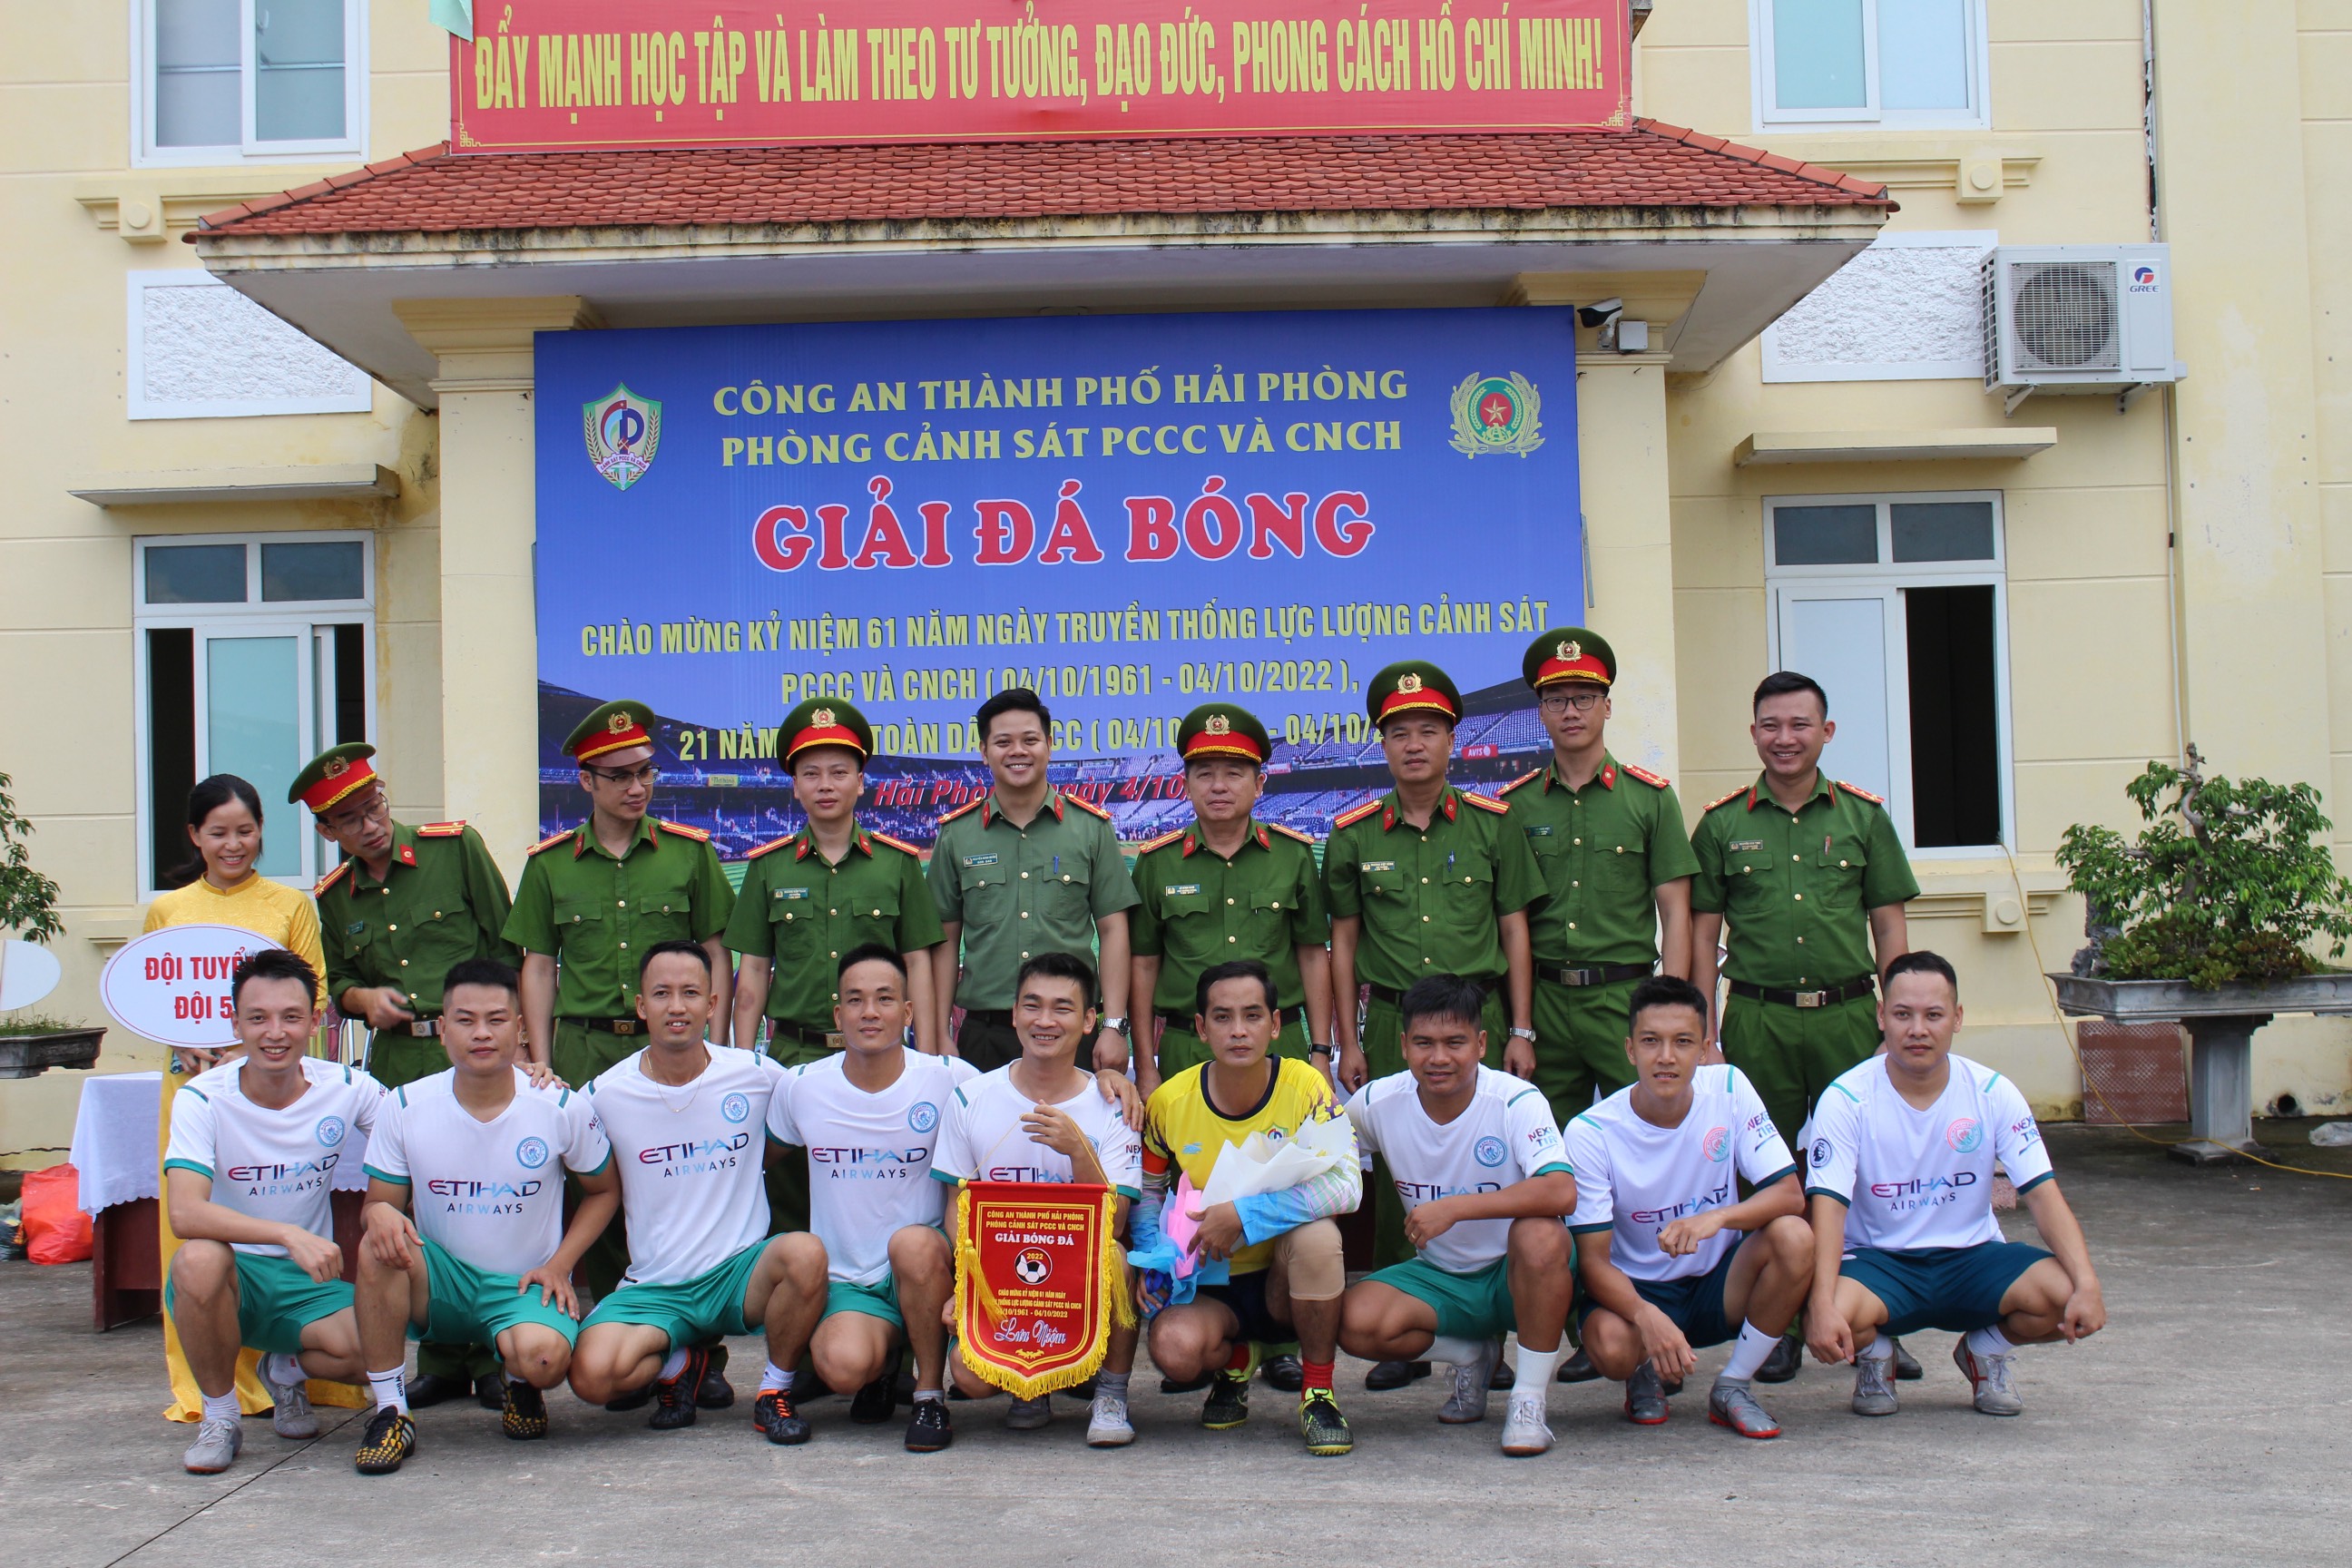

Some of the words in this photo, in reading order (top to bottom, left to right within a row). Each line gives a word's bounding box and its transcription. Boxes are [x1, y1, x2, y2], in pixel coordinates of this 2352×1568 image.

[475, 4, 529, 110] ĐẨY
[539, 33, 622, 124] MẠNH
[631, 31, 686, 122] HỌC
[693, 15, 747, 121] TẬP
[755, 14, 792, 103] VÀ
[799, 12, 859, 103] LÀM
[867, 26, 936, 101] THEO
[945, 18, 981, 100] TƯ
[986, 0, 1087, 105] TƯỞNG,
[1095, 23, 1152, 113] ĐẠO
[1160, 5, 1224, 103] ĐỨC,
[1233, 18, 1328, 94] PHONG
[1336, 3, 1411, 93] CÁCH
[1418, 0, 1456, 92] HỒ
[1465, 2, 1511, 91] CHÍ
[1519, 17, 1603, 90] MINH!
[2129, 285, 2160, 293] GREE
[713, 379, 836, 416] CÔNG
[847, 382, 906, 412] AN
[917, 373, 1063, 410] THÀNH
[1076, 366, 1161, 407] PHỐ
[1173, 364, 1245, 404] HẢI
[1258, 365, 1408, 401] PHÒNG
[721, 429, 872, 466] PHÒNG
[885, 422, 1001, 463] CẢNH
[1014, 423, 1089, 459] SÁT
[1102, 425, 1207, 456] PCCC
[1217, 417, 1276, 454] VÀ
[1285, 421, 1402, 452] CNCH
[752, 475, 952, 573] GIẢI
[973, 478, 1104, 567] ĐÁ
[1123, 475, 1376, 563] BÓNG
[582, 618, 653, 656] CHÀO
[661, 615, 740, 654] MỪNG
[749, 609, 783, 651] KỶ
[789, 612, 860, 656] NIỆM
[867, 617, 897, 649] 61
[906, 609, 969, 647] NĂM
[976, 608, 1049, 645] NGÀY
[1056, 600, 1160, 643] TRUYỀN
[1167, 597, 1258, 640] THỐNG
[1264, 603, 1315, 645] LỰC
[1322, 601, 1411, 644] LƯỢNG
[1417, 593, 1492, 635] CẢNH
[1499, 594, 1549, 632] SÁT
[781, 671, 855, 704] PCCC
[861, 664, 897, 702] VÀ
[903, 669, 976, 701] CNCH
[1002, 664, 1151, 697] 04/10/1961
[1179, 660, 1332, 693] 04/10/2022
[680, 730, 708, 760] 21
[720, 721, 778, 760] NĂM
[871, 718, 940, 755] TOÀN
[947, 715, 980, 754] DÂ
[1468, 747, 1483, 757] AVIS
[874, 778, 927, 806] Hải
[930, 778, 995, 805] Phò
[145, 952, 181, 985] ĐỘI
[190, 946, 253, 979] TUYỂ
[174, 991, 211, 1024] ĐỘI
[220, 996, 232, 1018] 5
[1747, 1110, 1770, 1131] NEXE
[1756, 1123, 1776, 1138] TIR
[1527, 1126, 1555, 1142] NEXE
[1535, 1137, 1557, 1148] TIR
[639, 1132, 749, 1164] ETIHAD
[812, 1147, 927, 1163] ETIHAD
[1125, 1144, 1142, 1154] NEX
[228, 1153, 339, 1181] ETIHAD
[663, 1157, 736, 1178] AIRWAYS
[831, 1169, 906, 1179] AIRWAYS
[989, 1167, 1073, 1183] ETIHA
[249, 1177, 322, 1196] AIRWAYS
[428, 1180, 542, 1198] ETIHAD
[1870, 1171, 1976, 1198] ETIHAD
[446, 1203, 523, 1214] AIRWAYS
[1890, 1192, 1956, 1211] AIRWAYS
[1067, 1223, 1084, 1231] CNCH
[995, 1230, 1020, 1242] GIẢI
[1023, 1232, 1054, 1245] BÓNG
[1057, 1234, 1074, 1245] ĐÁ
[1034, 1309, 1068, 1318] 04/10/2022
[994, 1317, 1030, 1342] Lưu
[1032, 1319, 1066, 1348] Niệm
